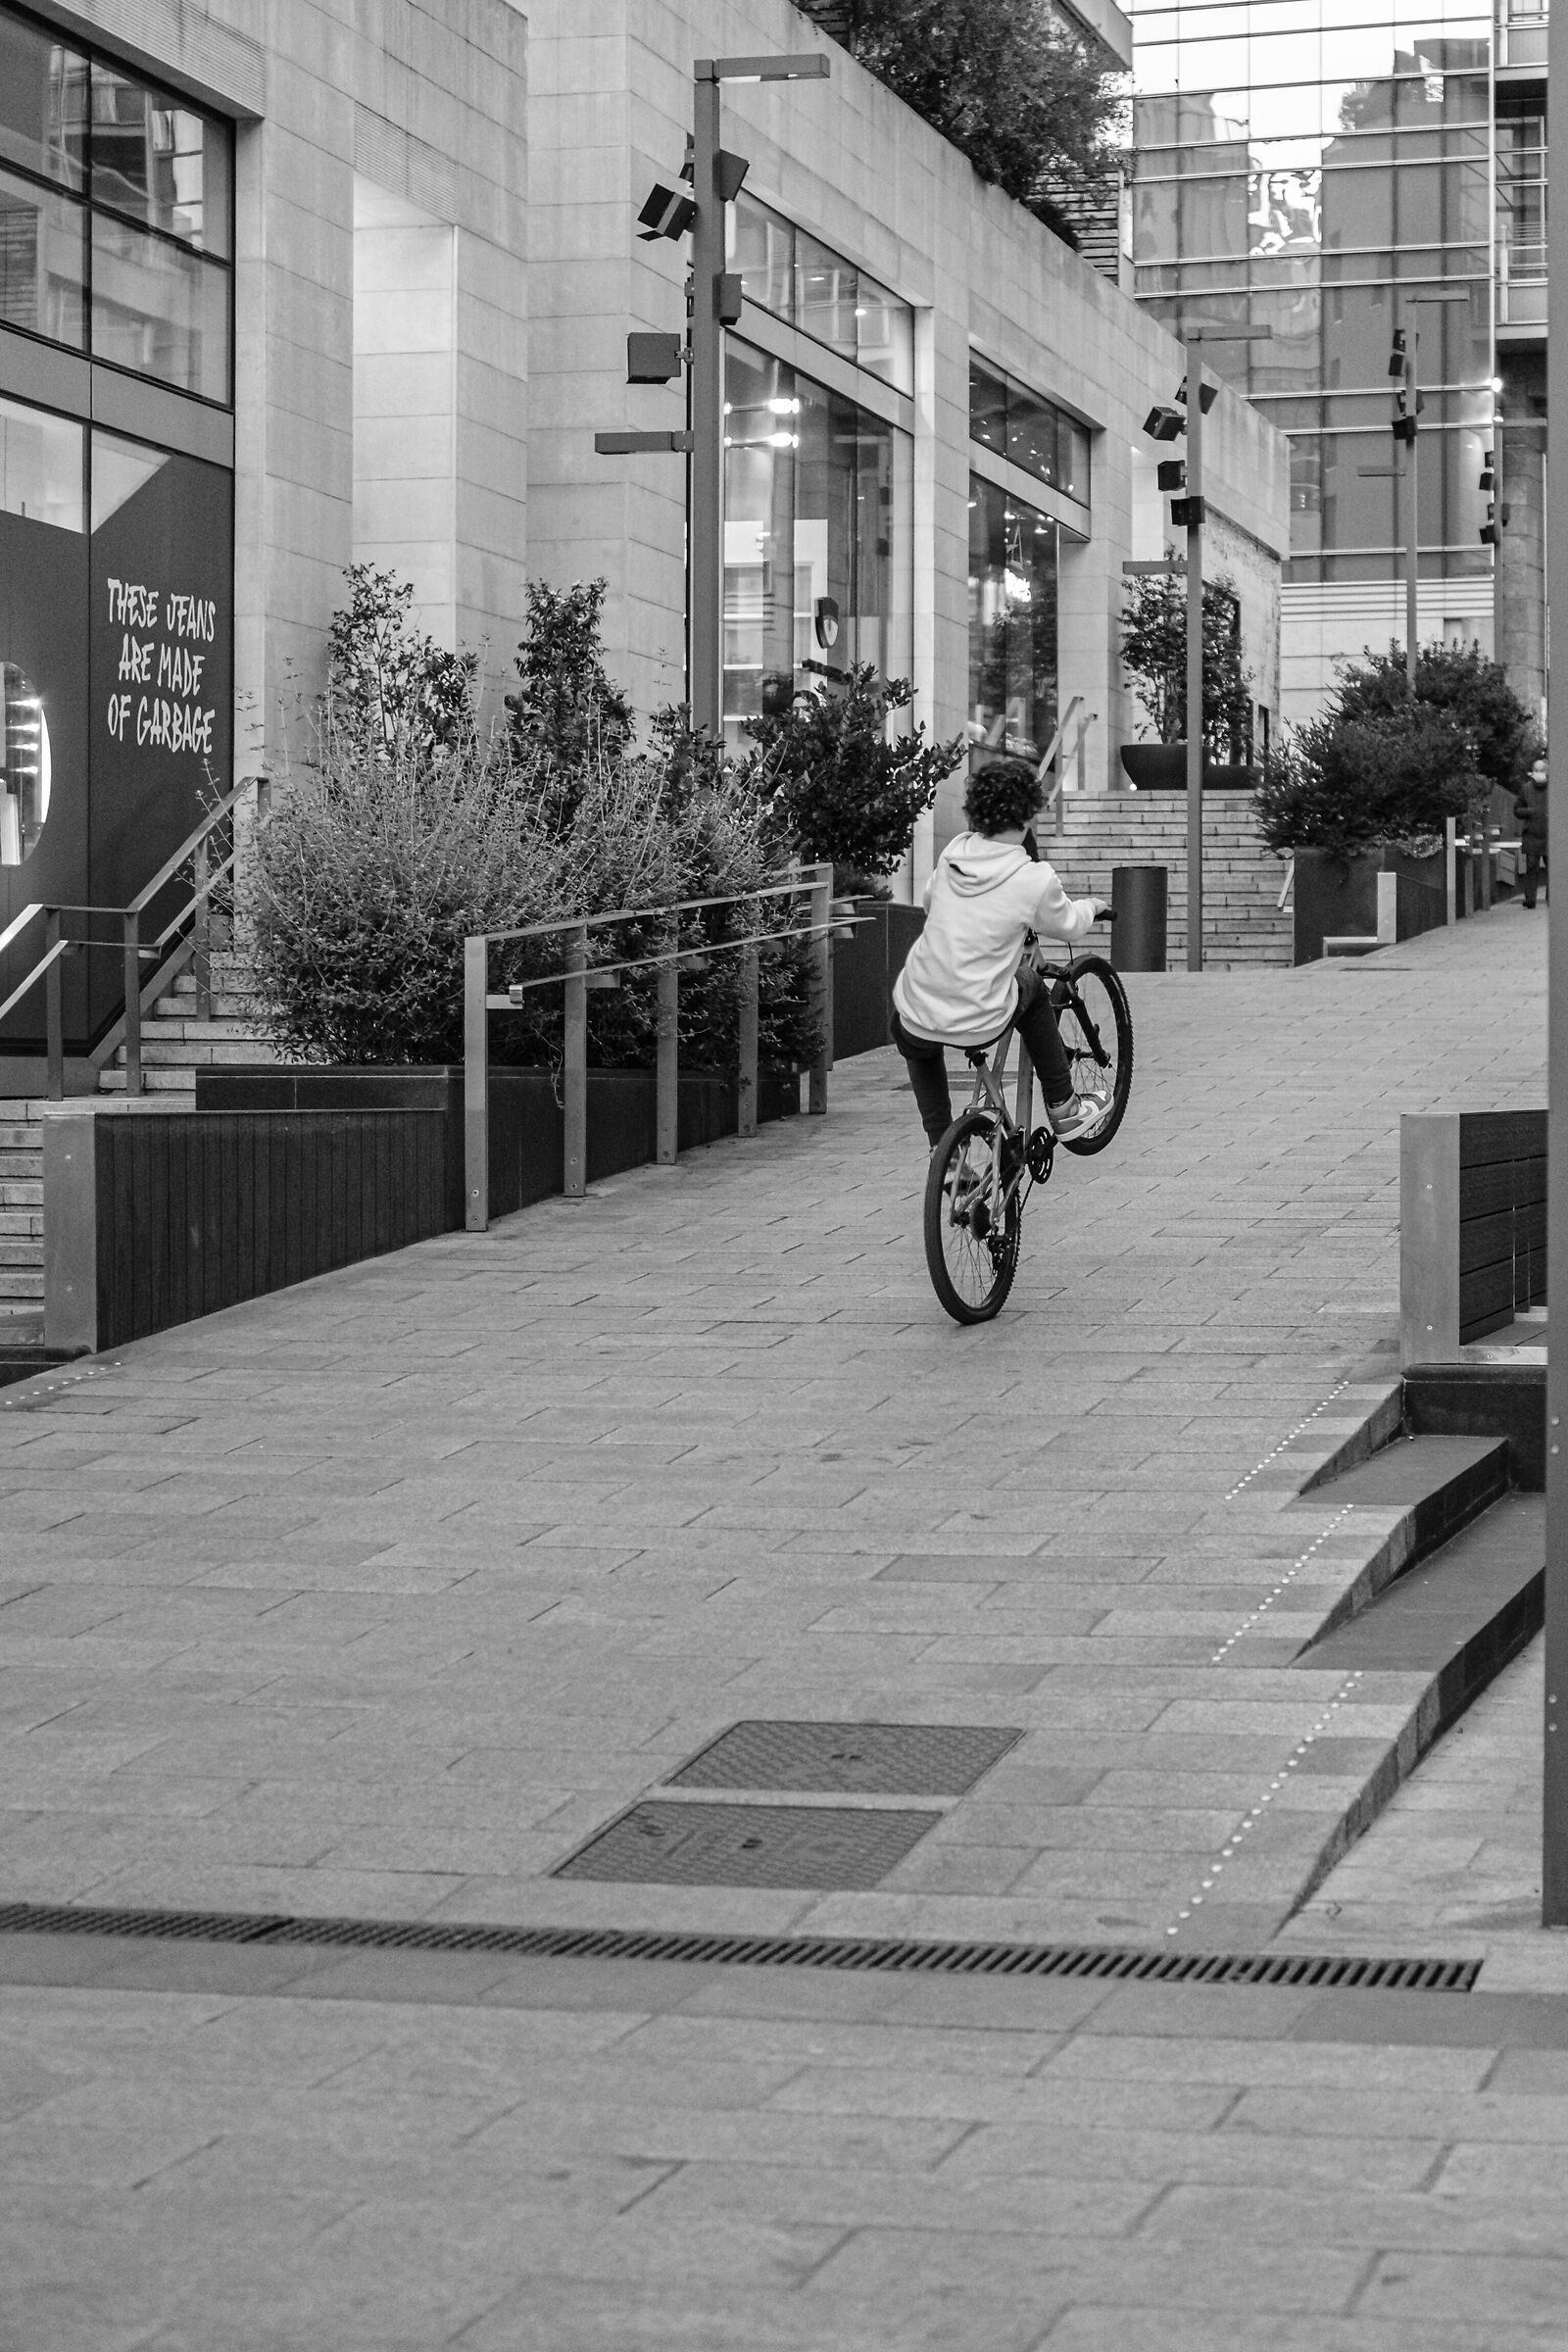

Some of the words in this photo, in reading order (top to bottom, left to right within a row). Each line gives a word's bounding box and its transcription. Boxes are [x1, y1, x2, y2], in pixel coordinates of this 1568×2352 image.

[108, 577, 159, 627] THESE
[167, 593, 216, 642] JEANS
[119, 633, 155, 684] ARE
[158, 643, 205, 697] MADE
[108, 694, 131, 742] OF
[137, 696, 216, 754] GARBAGE
